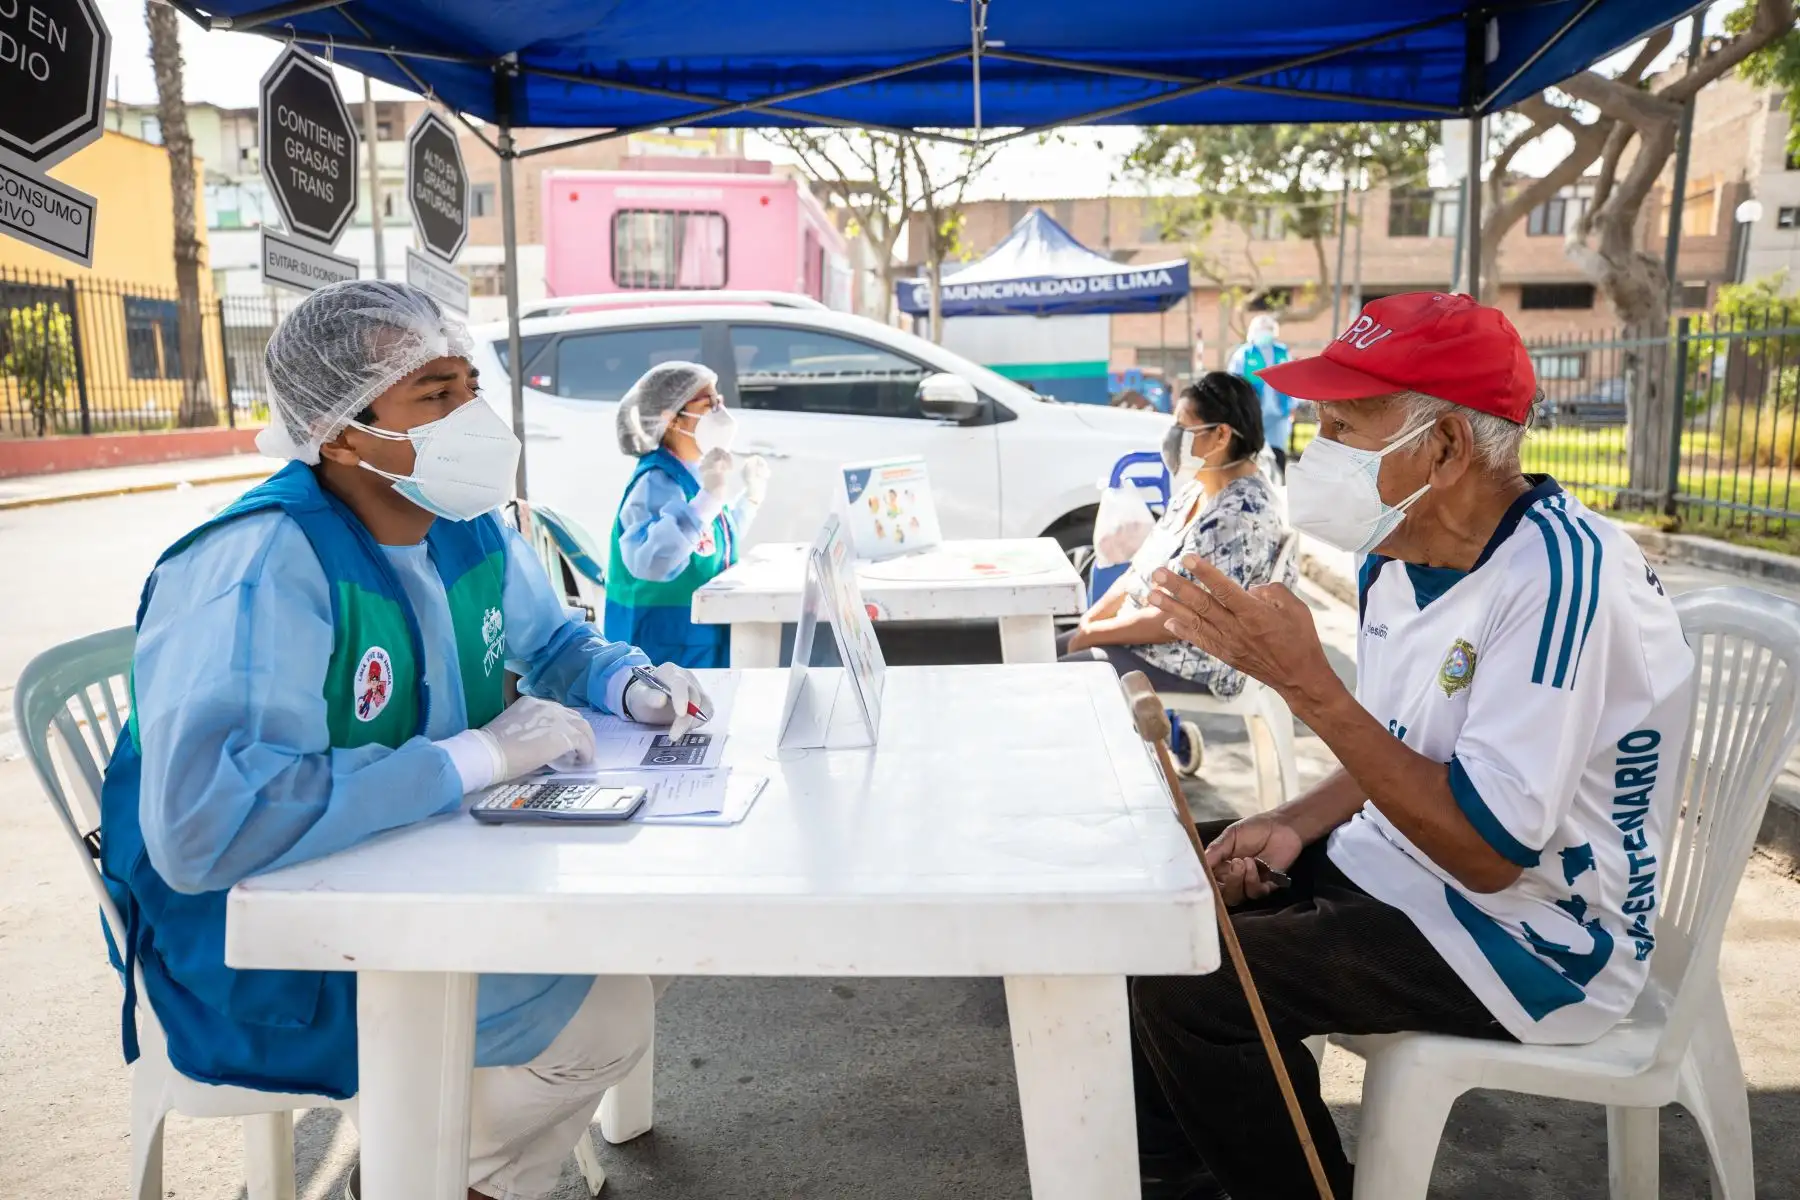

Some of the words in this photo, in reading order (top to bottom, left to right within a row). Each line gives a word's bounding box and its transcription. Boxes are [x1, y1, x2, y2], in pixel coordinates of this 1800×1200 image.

[28, 6, 67, 52] EN
[277, 104, 345, 157] CONTIENE
[284, 136, 339, 179] GRASAS
[289, 165, 335, 203] TRANS
[0, 198, 35, 227] IVO
[269, 252, 299, 273] EVITAR
[300, 262, 312, 277] SU
[313, 266, 354, 284] CONSU
[942, 278, 1087, 301] MUNICIPALIDAD
[1088, 275, 1115, 293] DE
[1116, 269, 1173, 290] LIMA
[1340, 315, 1393, 350] RU
